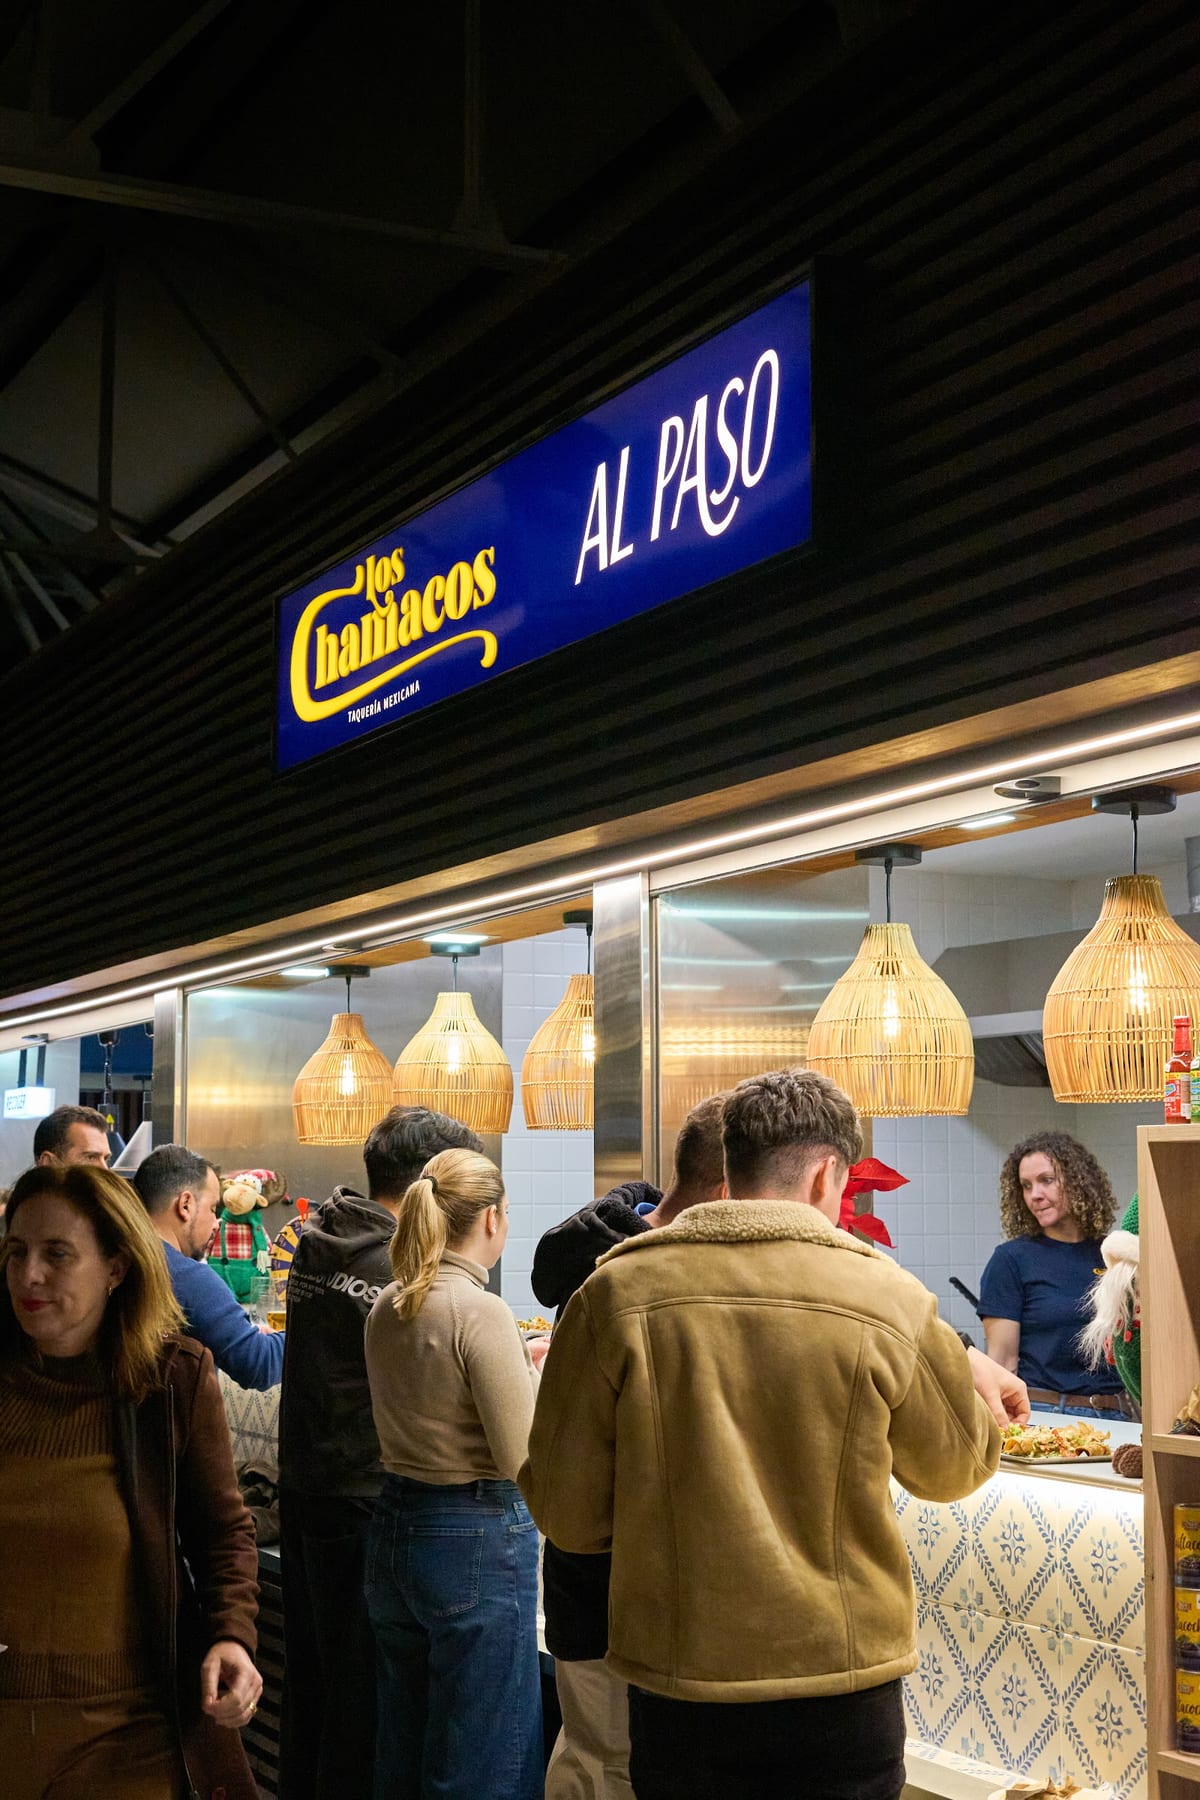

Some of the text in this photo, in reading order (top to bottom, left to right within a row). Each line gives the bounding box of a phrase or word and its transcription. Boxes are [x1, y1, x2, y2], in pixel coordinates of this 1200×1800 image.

[574, 348, 780, 586] AL PASO
[289, 546, 498, 723] Chamacos
[365, 546, 406, 616] los
[347, 679, 420, 724] TAQUERÍA MEXICANA
